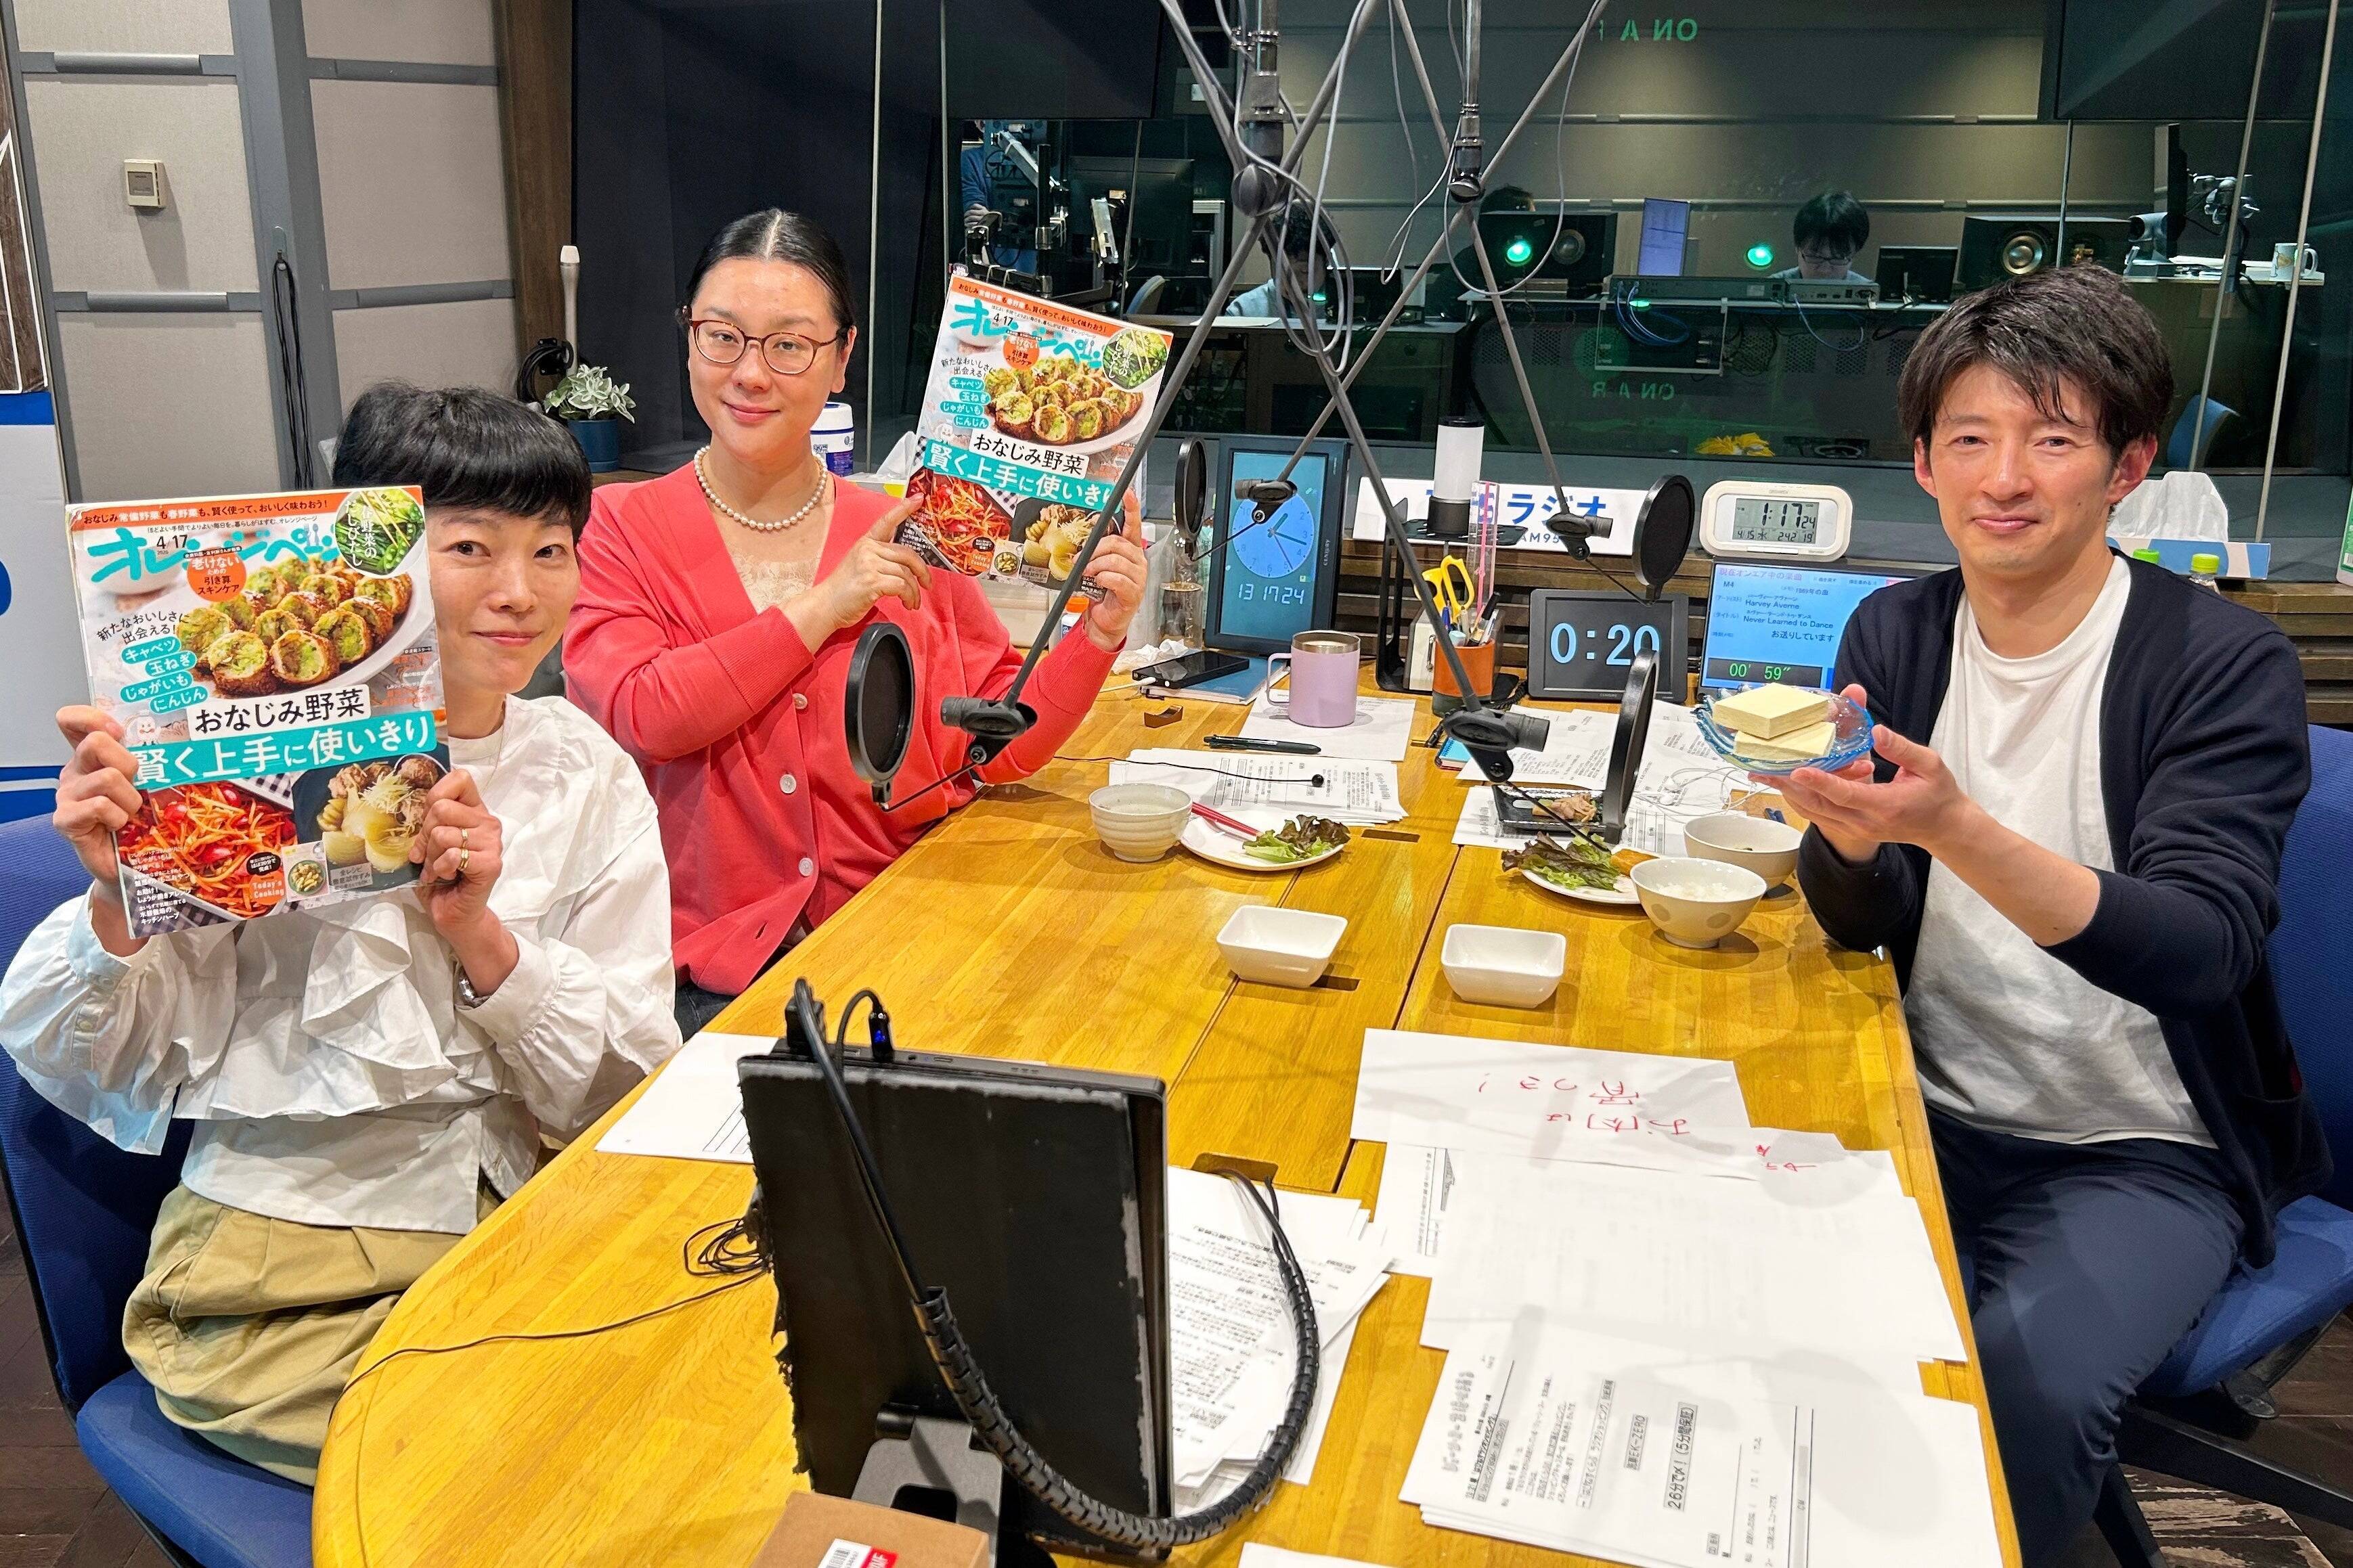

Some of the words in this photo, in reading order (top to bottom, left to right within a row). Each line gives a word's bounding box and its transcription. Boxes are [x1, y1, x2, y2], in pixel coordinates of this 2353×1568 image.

[952, 378, 982, 390] キャベツ
[962, 392, 988, 403] 玉ねぎ
[943, 402, 981, 416] じゃがいも
[955, 417, 987, 428] にんじん
[973, 434, 1084, 475] おなじみ野菜
[1761, 502, 1803, 528] 1:17
[1801, 516, 1816, 529] 24
[198, 584, 240, 596] スキンケア
[204, 575, 231, 585] 引き算
[1238, 583, 1254, 600] 13
[1281, 587, 1305, 604] 24
[1745, 600, 1771, 608] Harvey
[96, 610, 190, 642] 新たなおいしさに
[1743, 615, 1765, 623] Never
[1767, 617, 1797, 626] Learned
[1810, 621, 1834, 629] Dance
[122, 624, 176, 645] 出会える！
[1550, 623, 1660, 666] 0:20
[1771, 630, 1834, 642] お送りしています
[125, 639, 176, 661] キャベツ
[149, 652, 190, 676] 玉ねぎ
[125, 673, 188, 700] じゃがいも
[153, 688, 206, 712] にんじん
[194, 688, 365, 734] おなじみ野菜
[135, 715, 429, 785] 賢く上手に使いきり
[1546, 1111, 1690, 1136] お肉は
